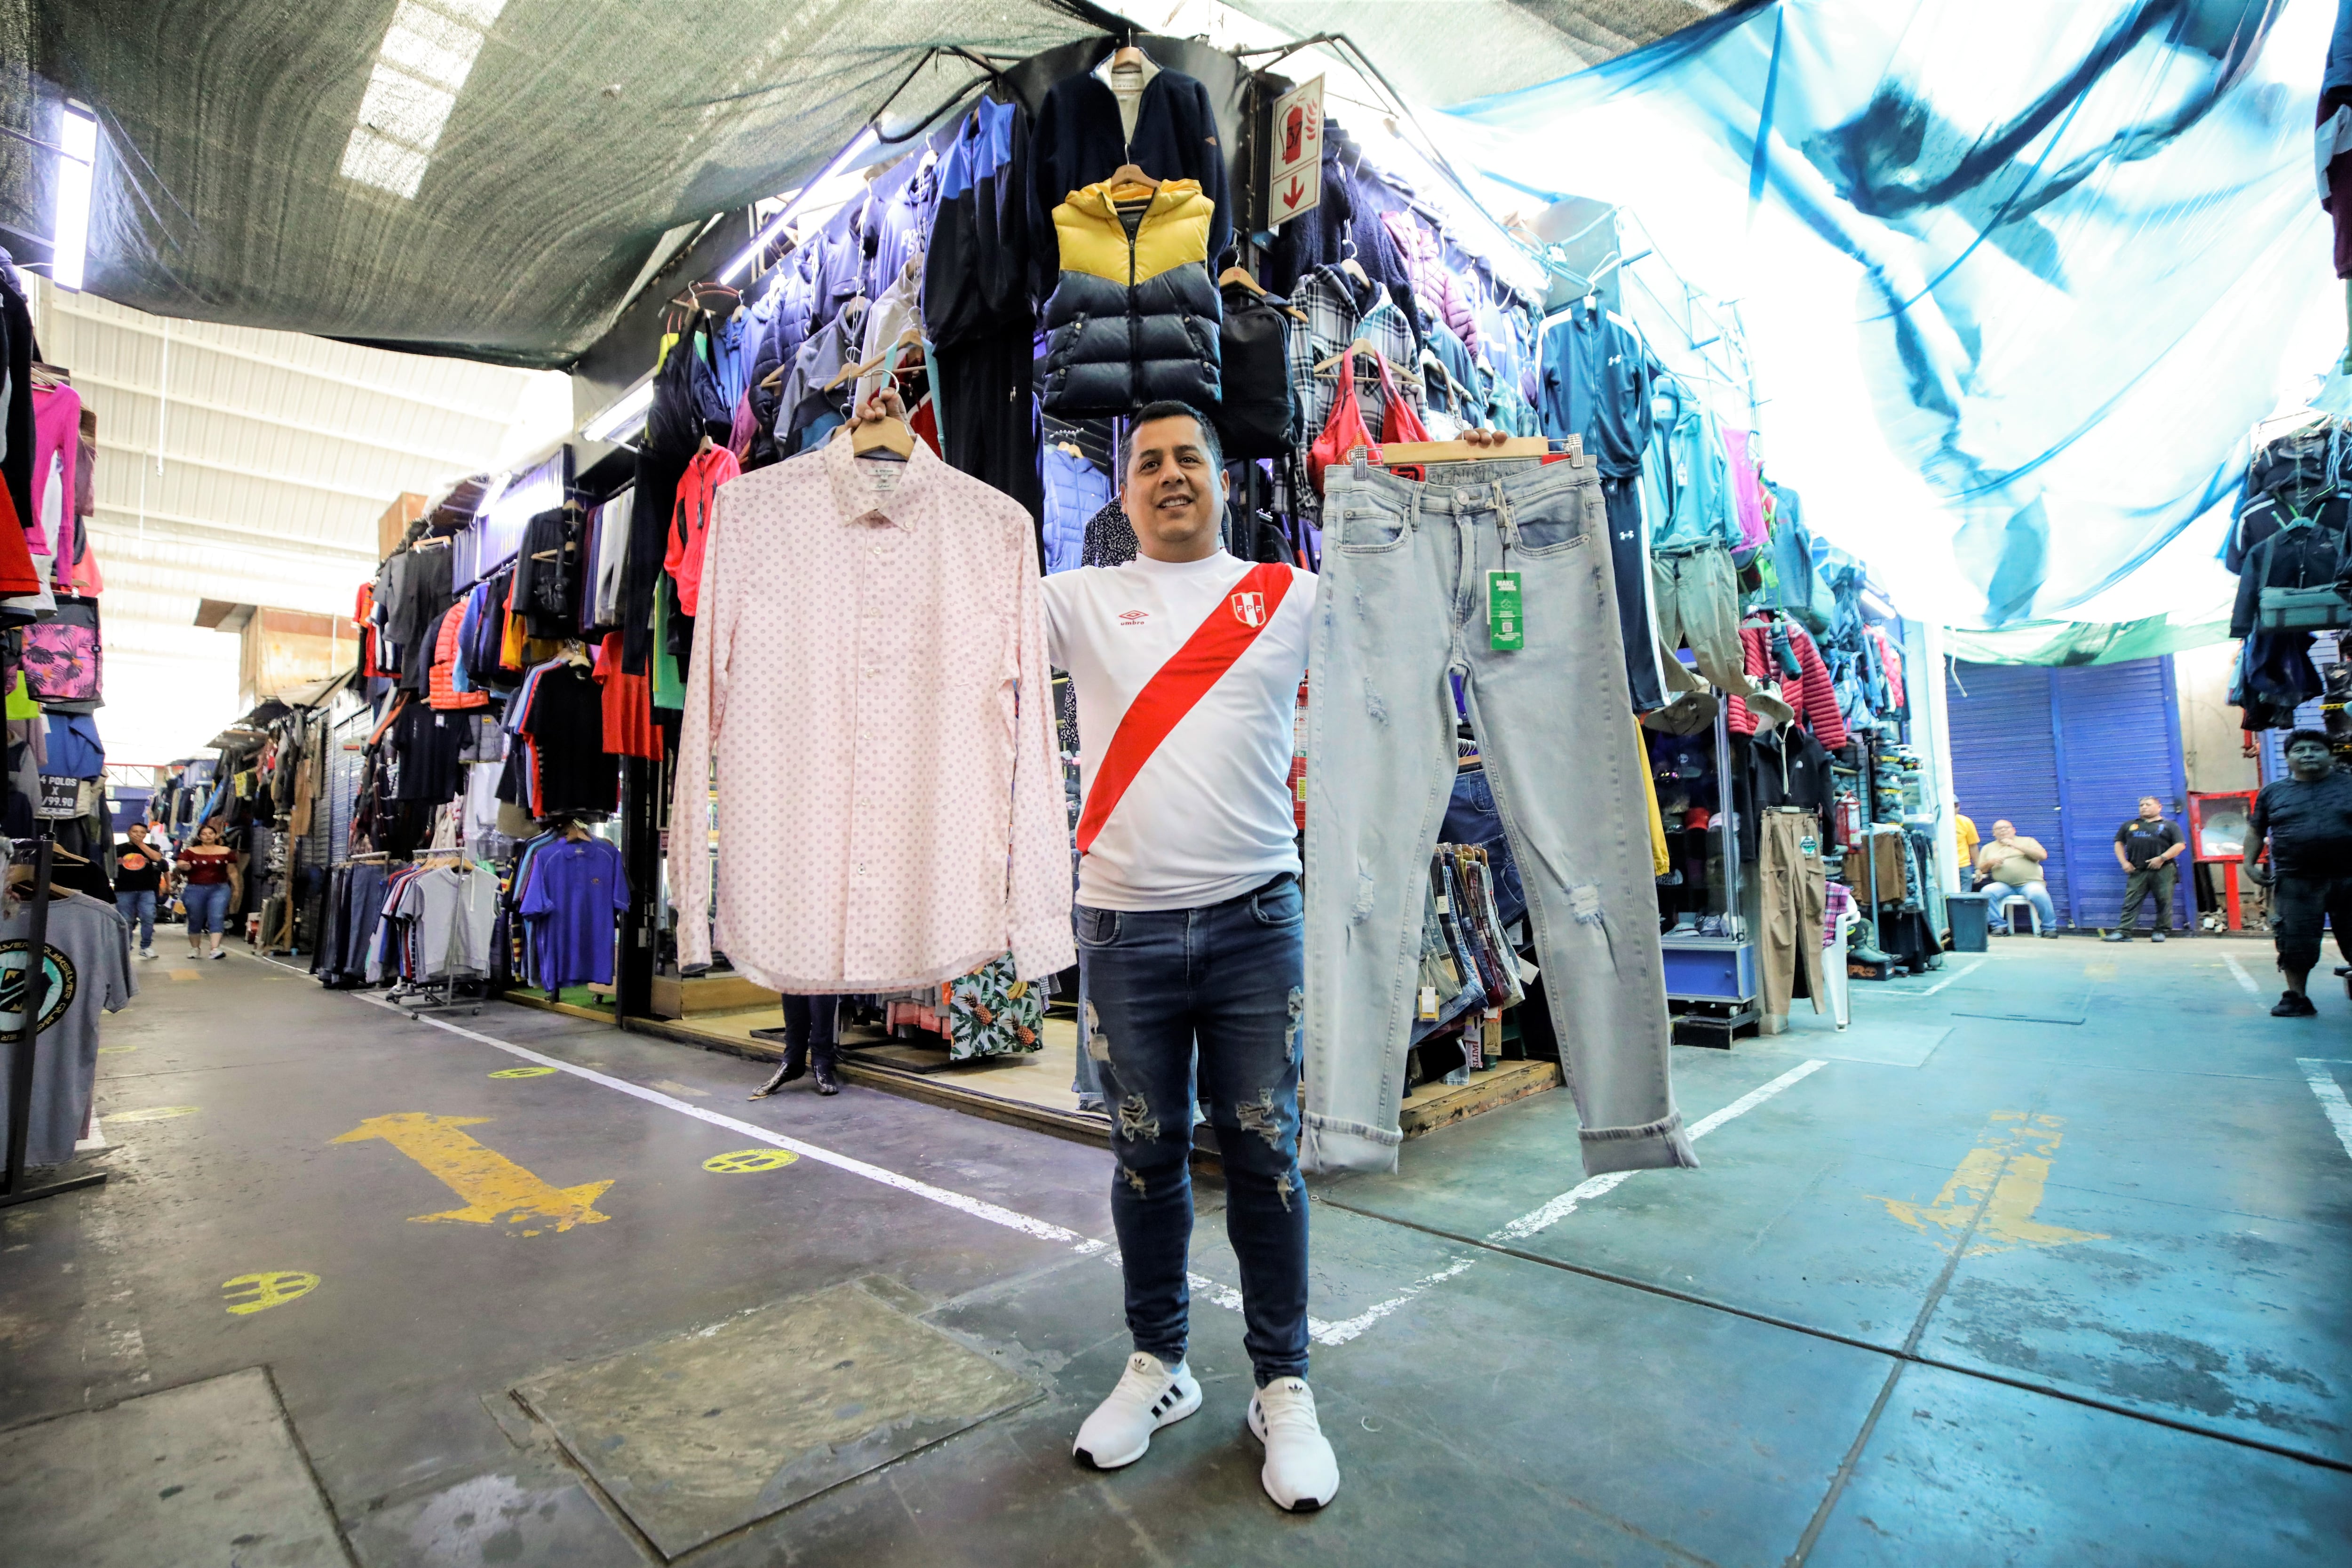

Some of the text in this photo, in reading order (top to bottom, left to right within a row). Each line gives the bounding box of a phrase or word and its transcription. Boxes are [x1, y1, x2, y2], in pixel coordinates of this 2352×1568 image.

[1287, 120, 1303, 149] 37
[48, 776, 77, 787] POLOS
[41, 796, 74, 807] /99.90
